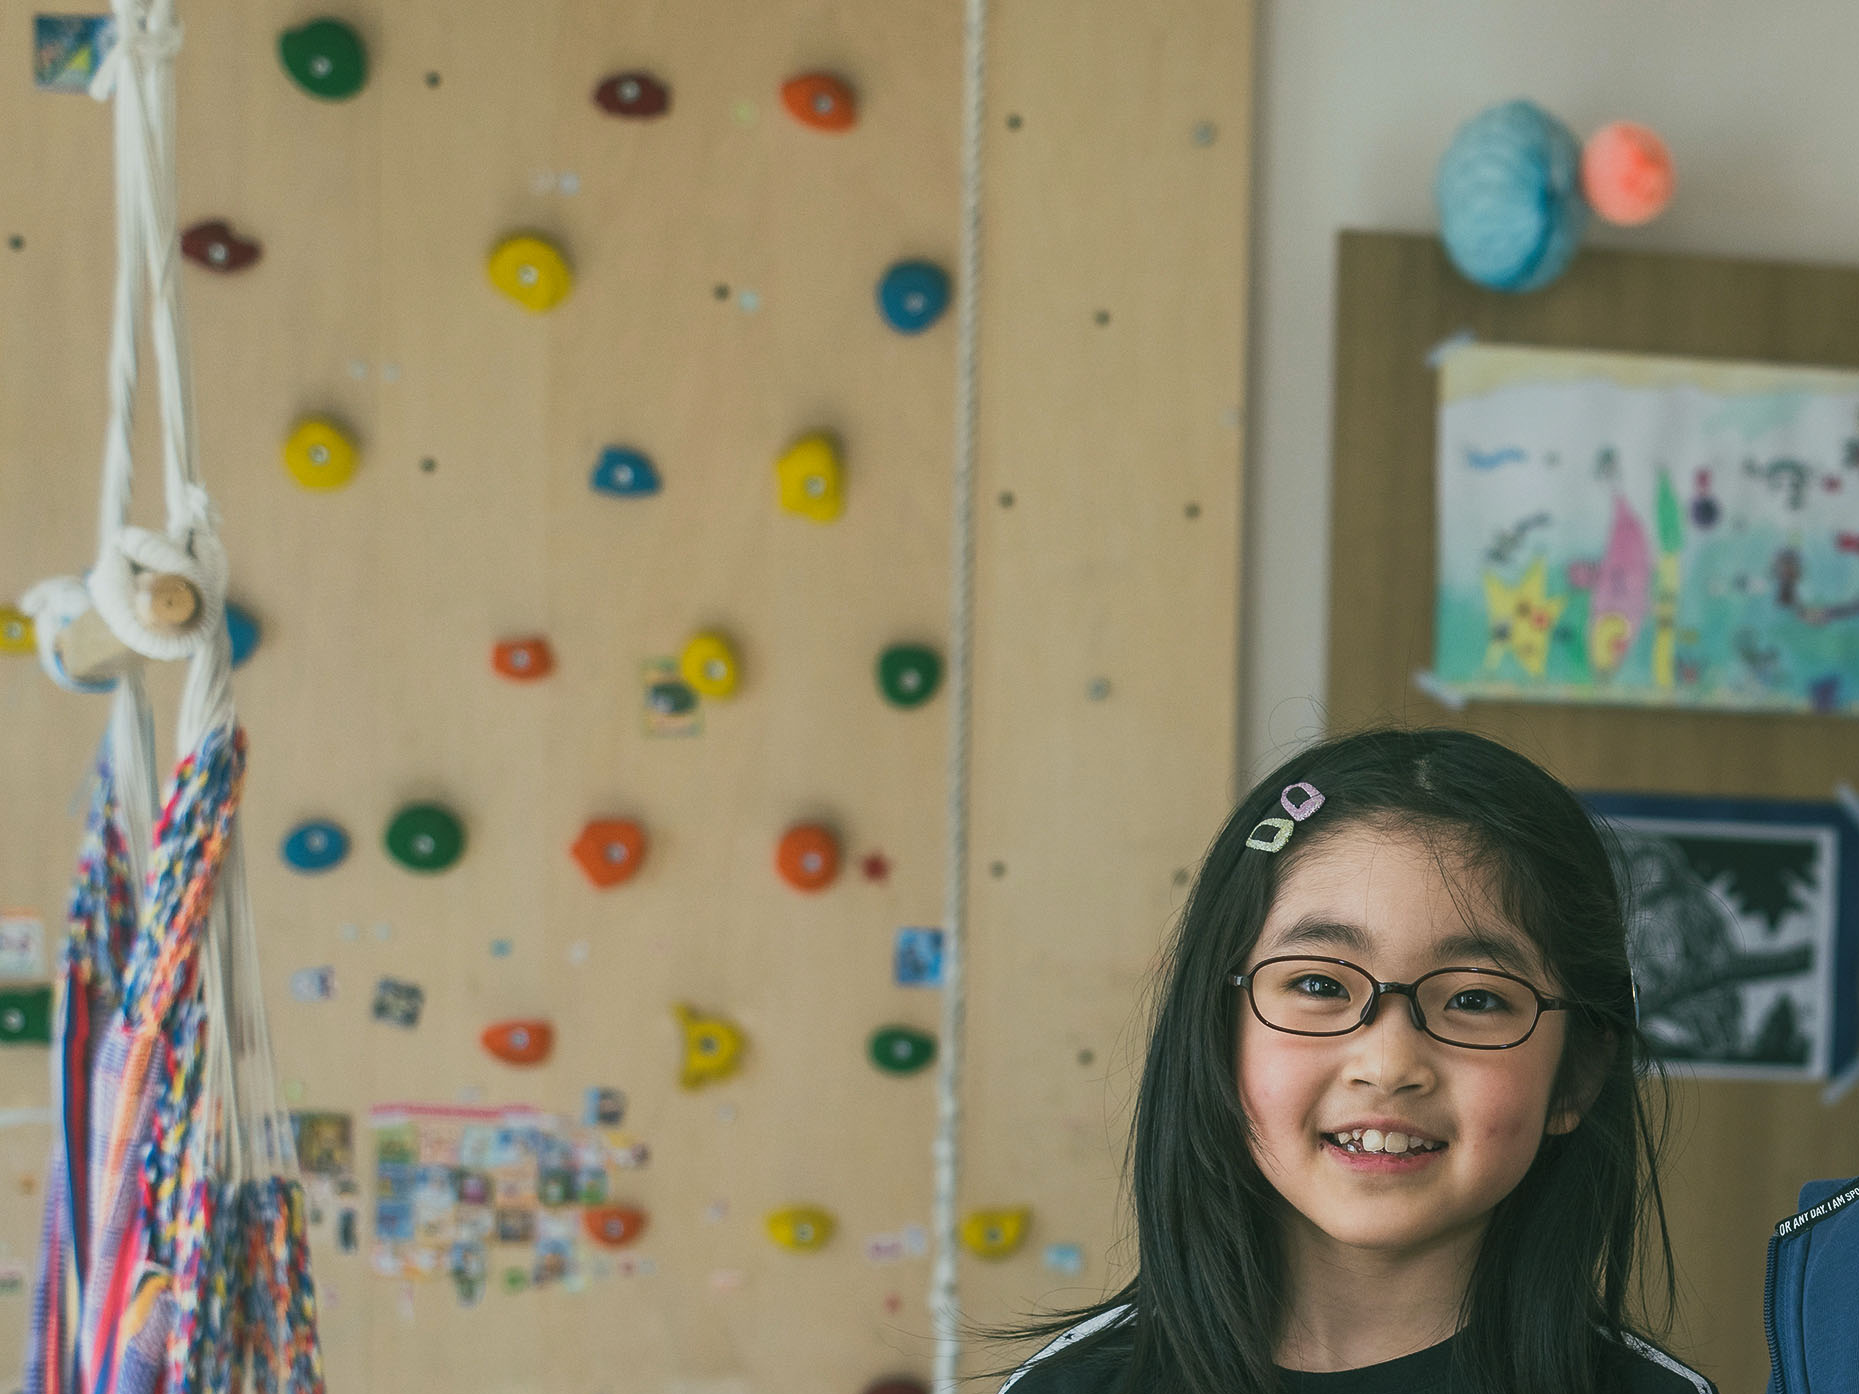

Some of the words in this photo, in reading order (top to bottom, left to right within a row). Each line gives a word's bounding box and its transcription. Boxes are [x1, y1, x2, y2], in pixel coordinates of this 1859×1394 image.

[1779, 1220, 1792, 1237] OR
[1793, 1212, 1809, 1229] ANY
[1810, 1204, 1828, 1219] DAY.
[1827, 1201, 1832, 1211] I
[1832, 1195, 1846, 1209] AM
